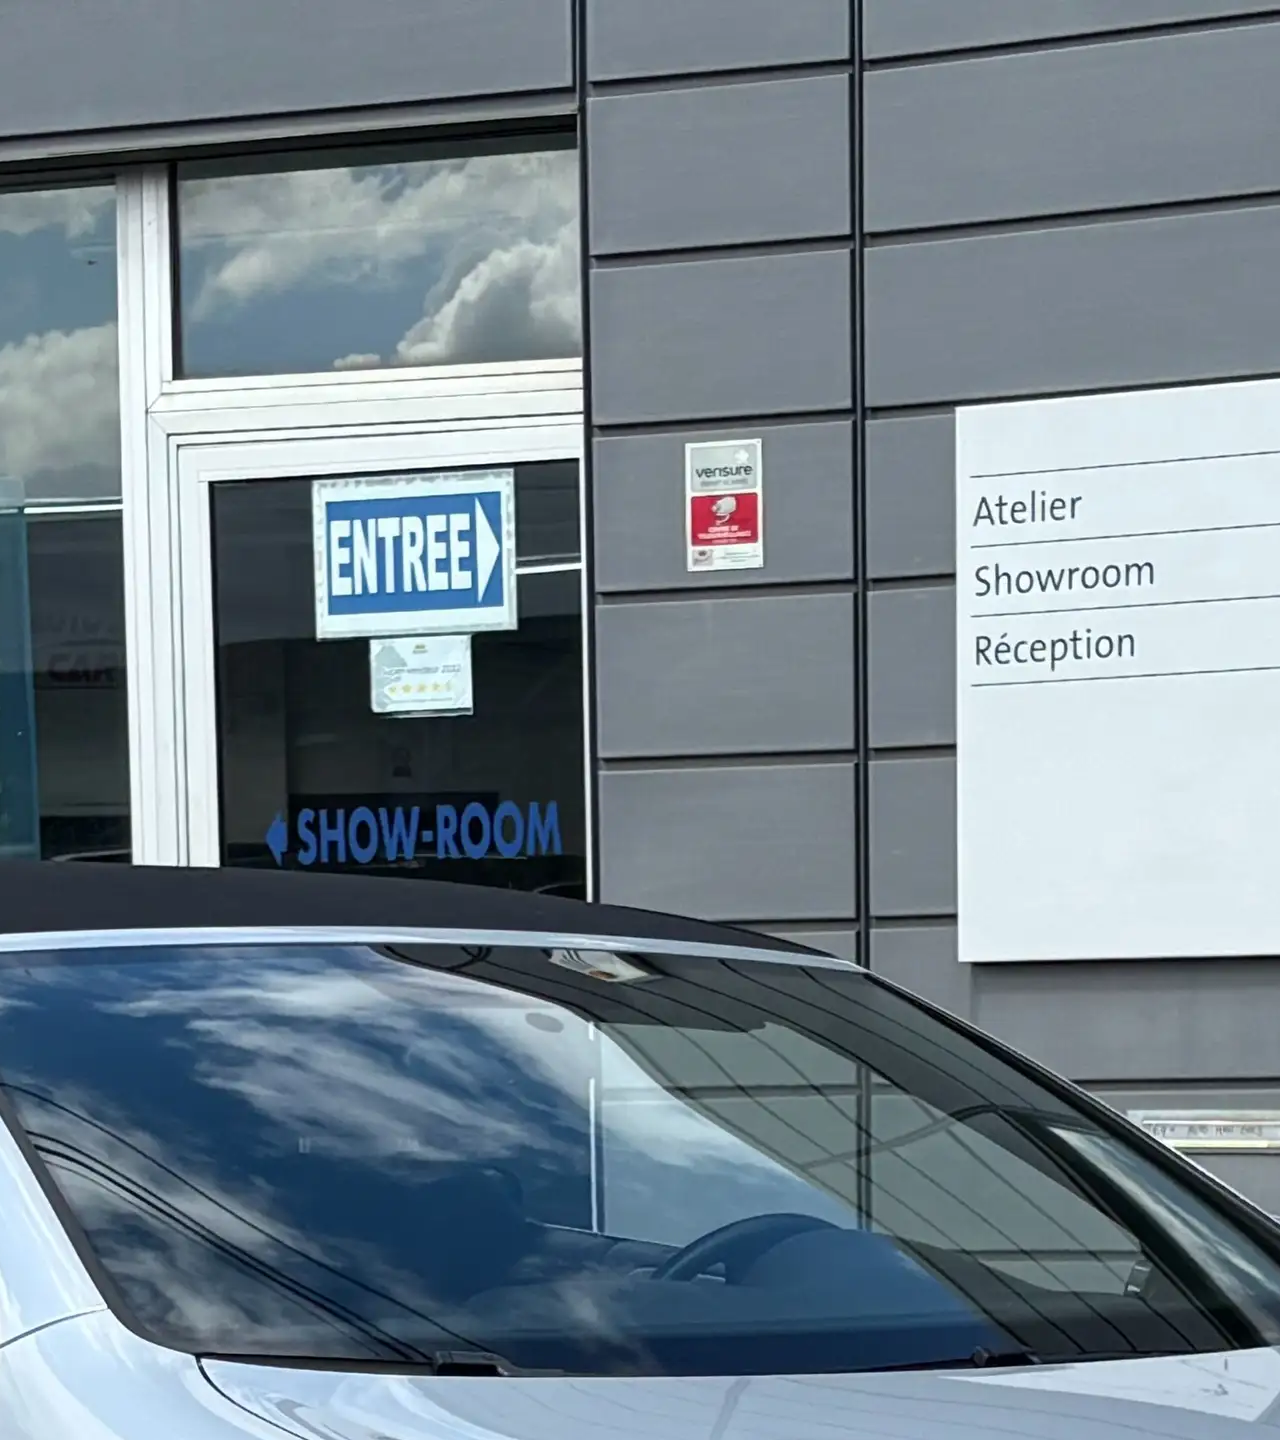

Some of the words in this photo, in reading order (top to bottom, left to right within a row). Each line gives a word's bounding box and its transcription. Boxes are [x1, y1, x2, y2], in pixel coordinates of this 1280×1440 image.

[972, 490, 1083, 529] Atelier
[328, 511, 474, 597] ENTREE
[974, 560, 1156, 598] Showroom
[973, 628, 1137, 672] Réception
[295, 800, 563, 867] SHOW-ROOM
